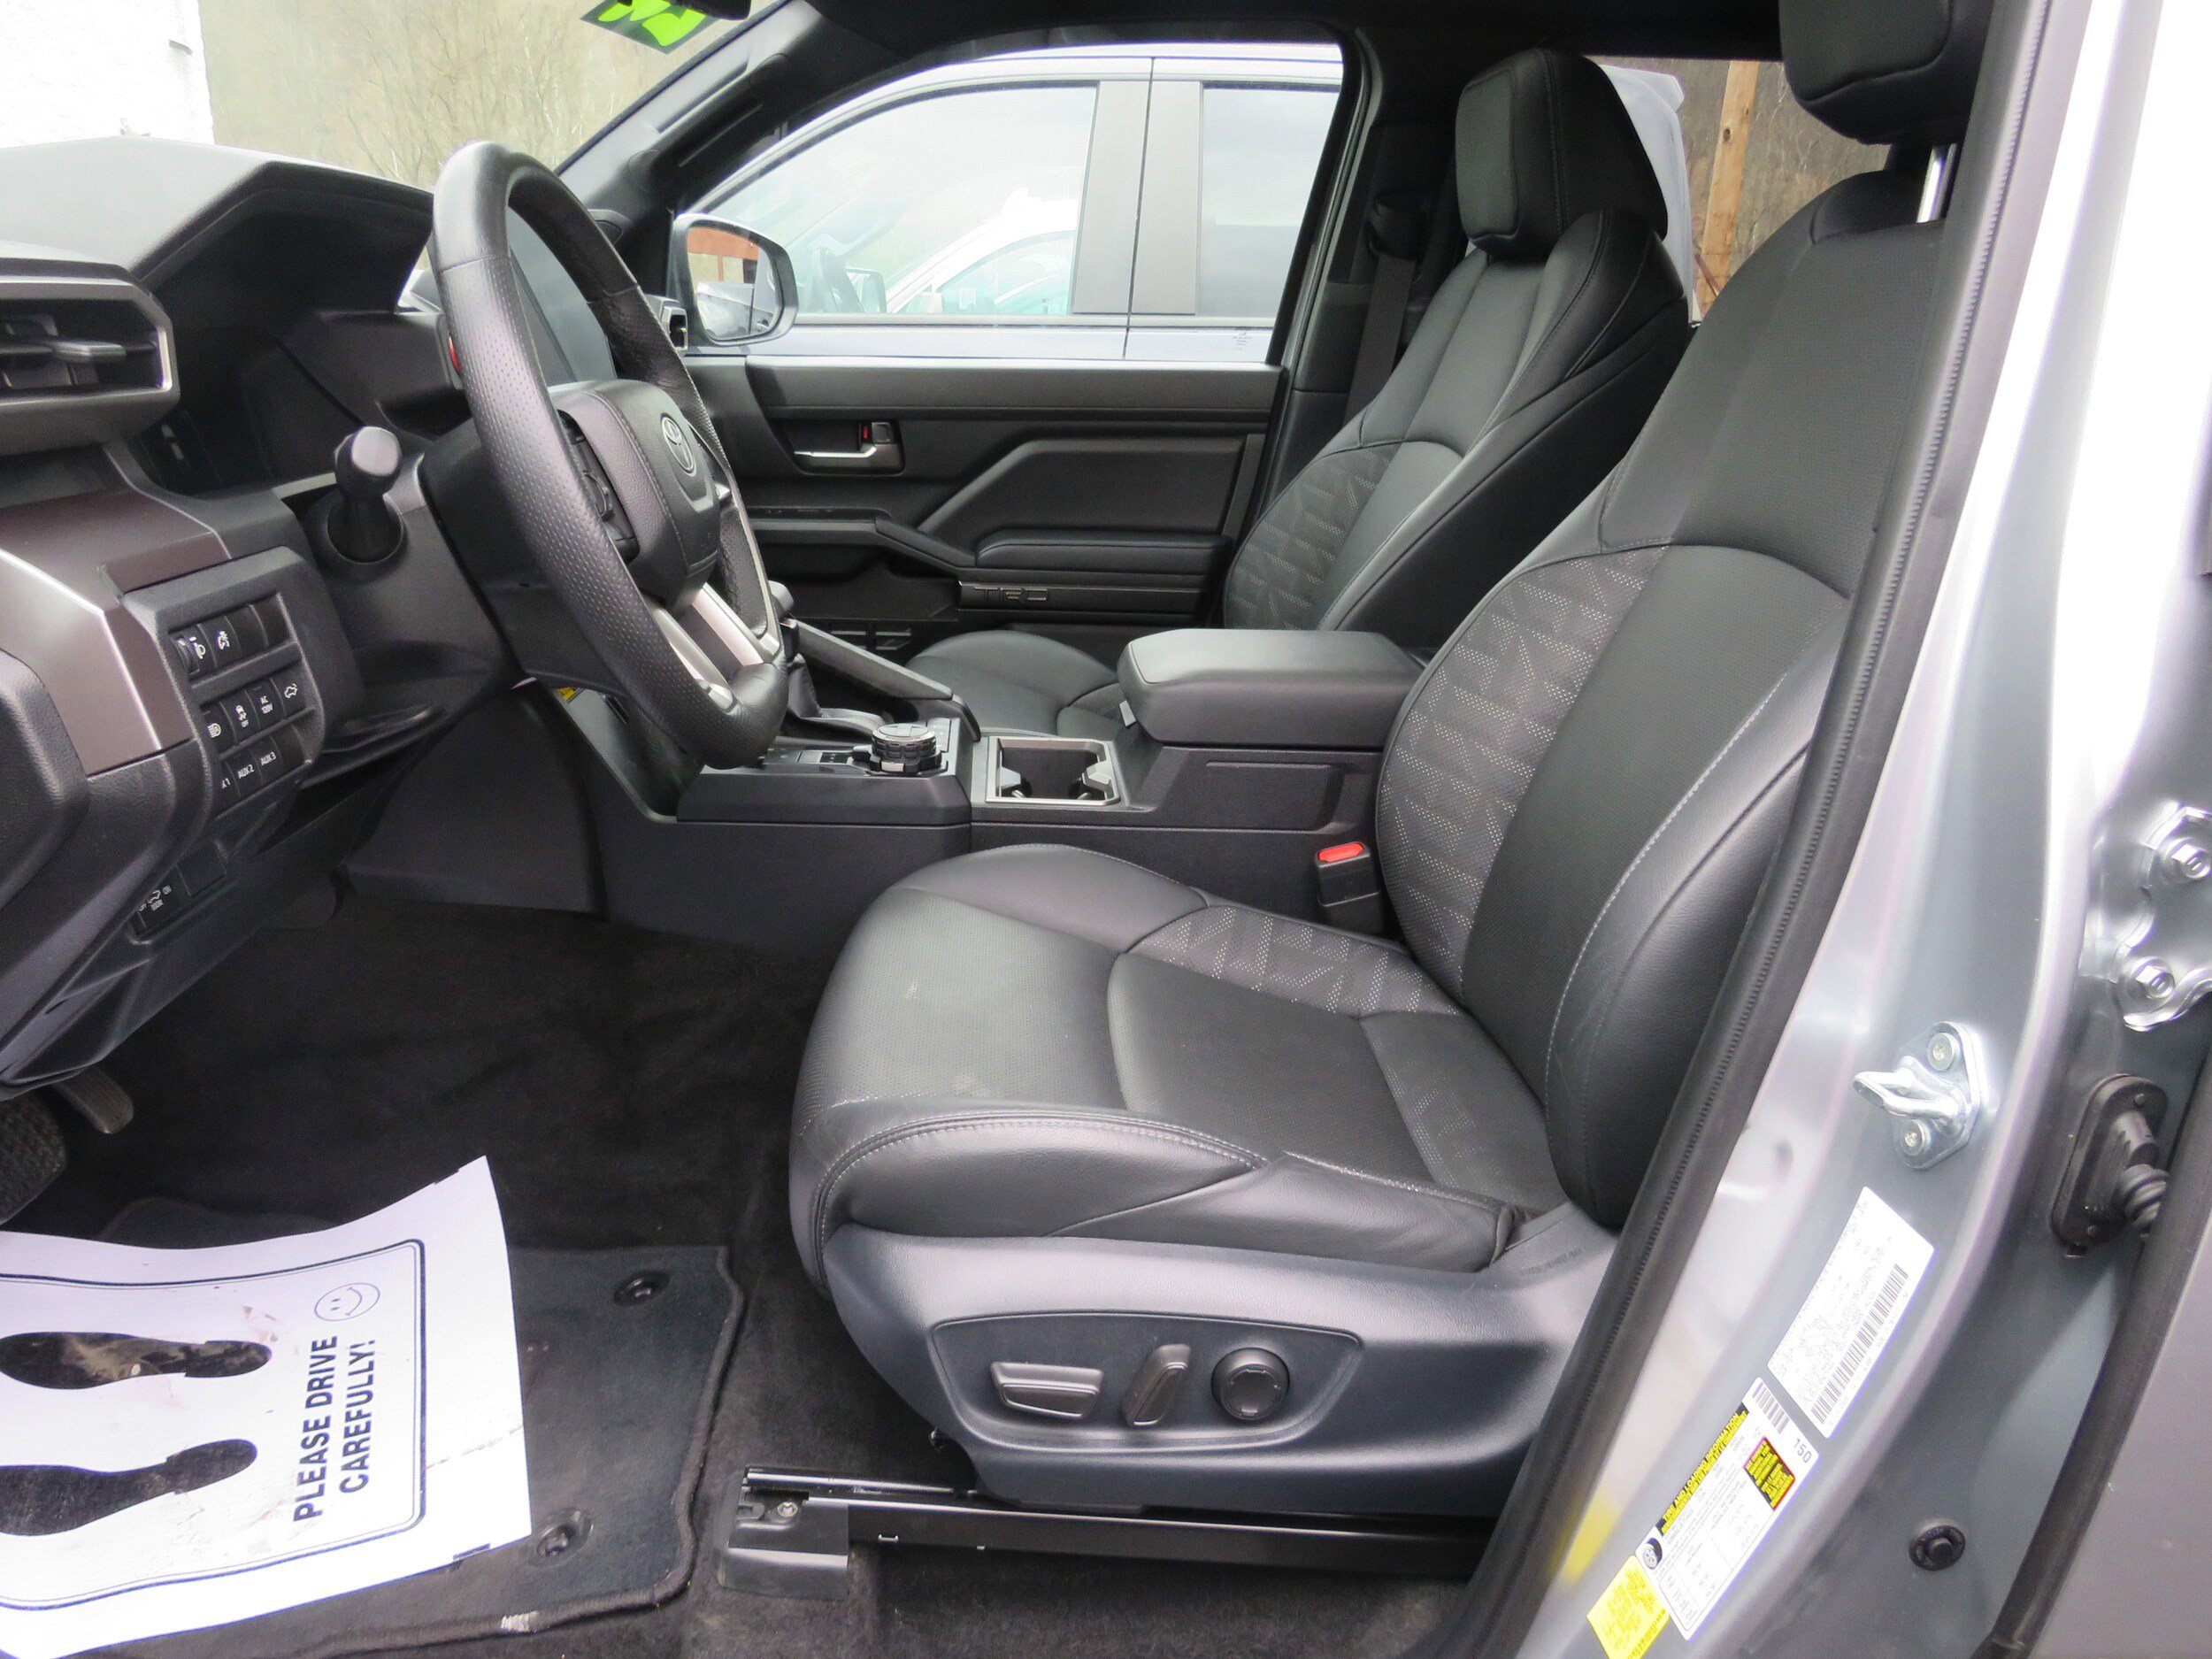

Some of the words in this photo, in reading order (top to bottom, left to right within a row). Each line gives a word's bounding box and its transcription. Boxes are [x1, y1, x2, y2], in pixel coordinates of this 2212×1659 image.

[304, 1335, 338, 1409] DRIVE
[339, 1340, 375, 1494] CAREFULLY!
[293, 1415, 331, 1522] PLEASE
[1662, 1502, 1675, 1522] TIRE
[1672, 1487, 1686, 1507] AND
[1683, 1458, 1707, 1491] LOADING
[1704, 1411, 1739, 1461] INFORMATION
[1793, 1438, 1812, 1463] 150
